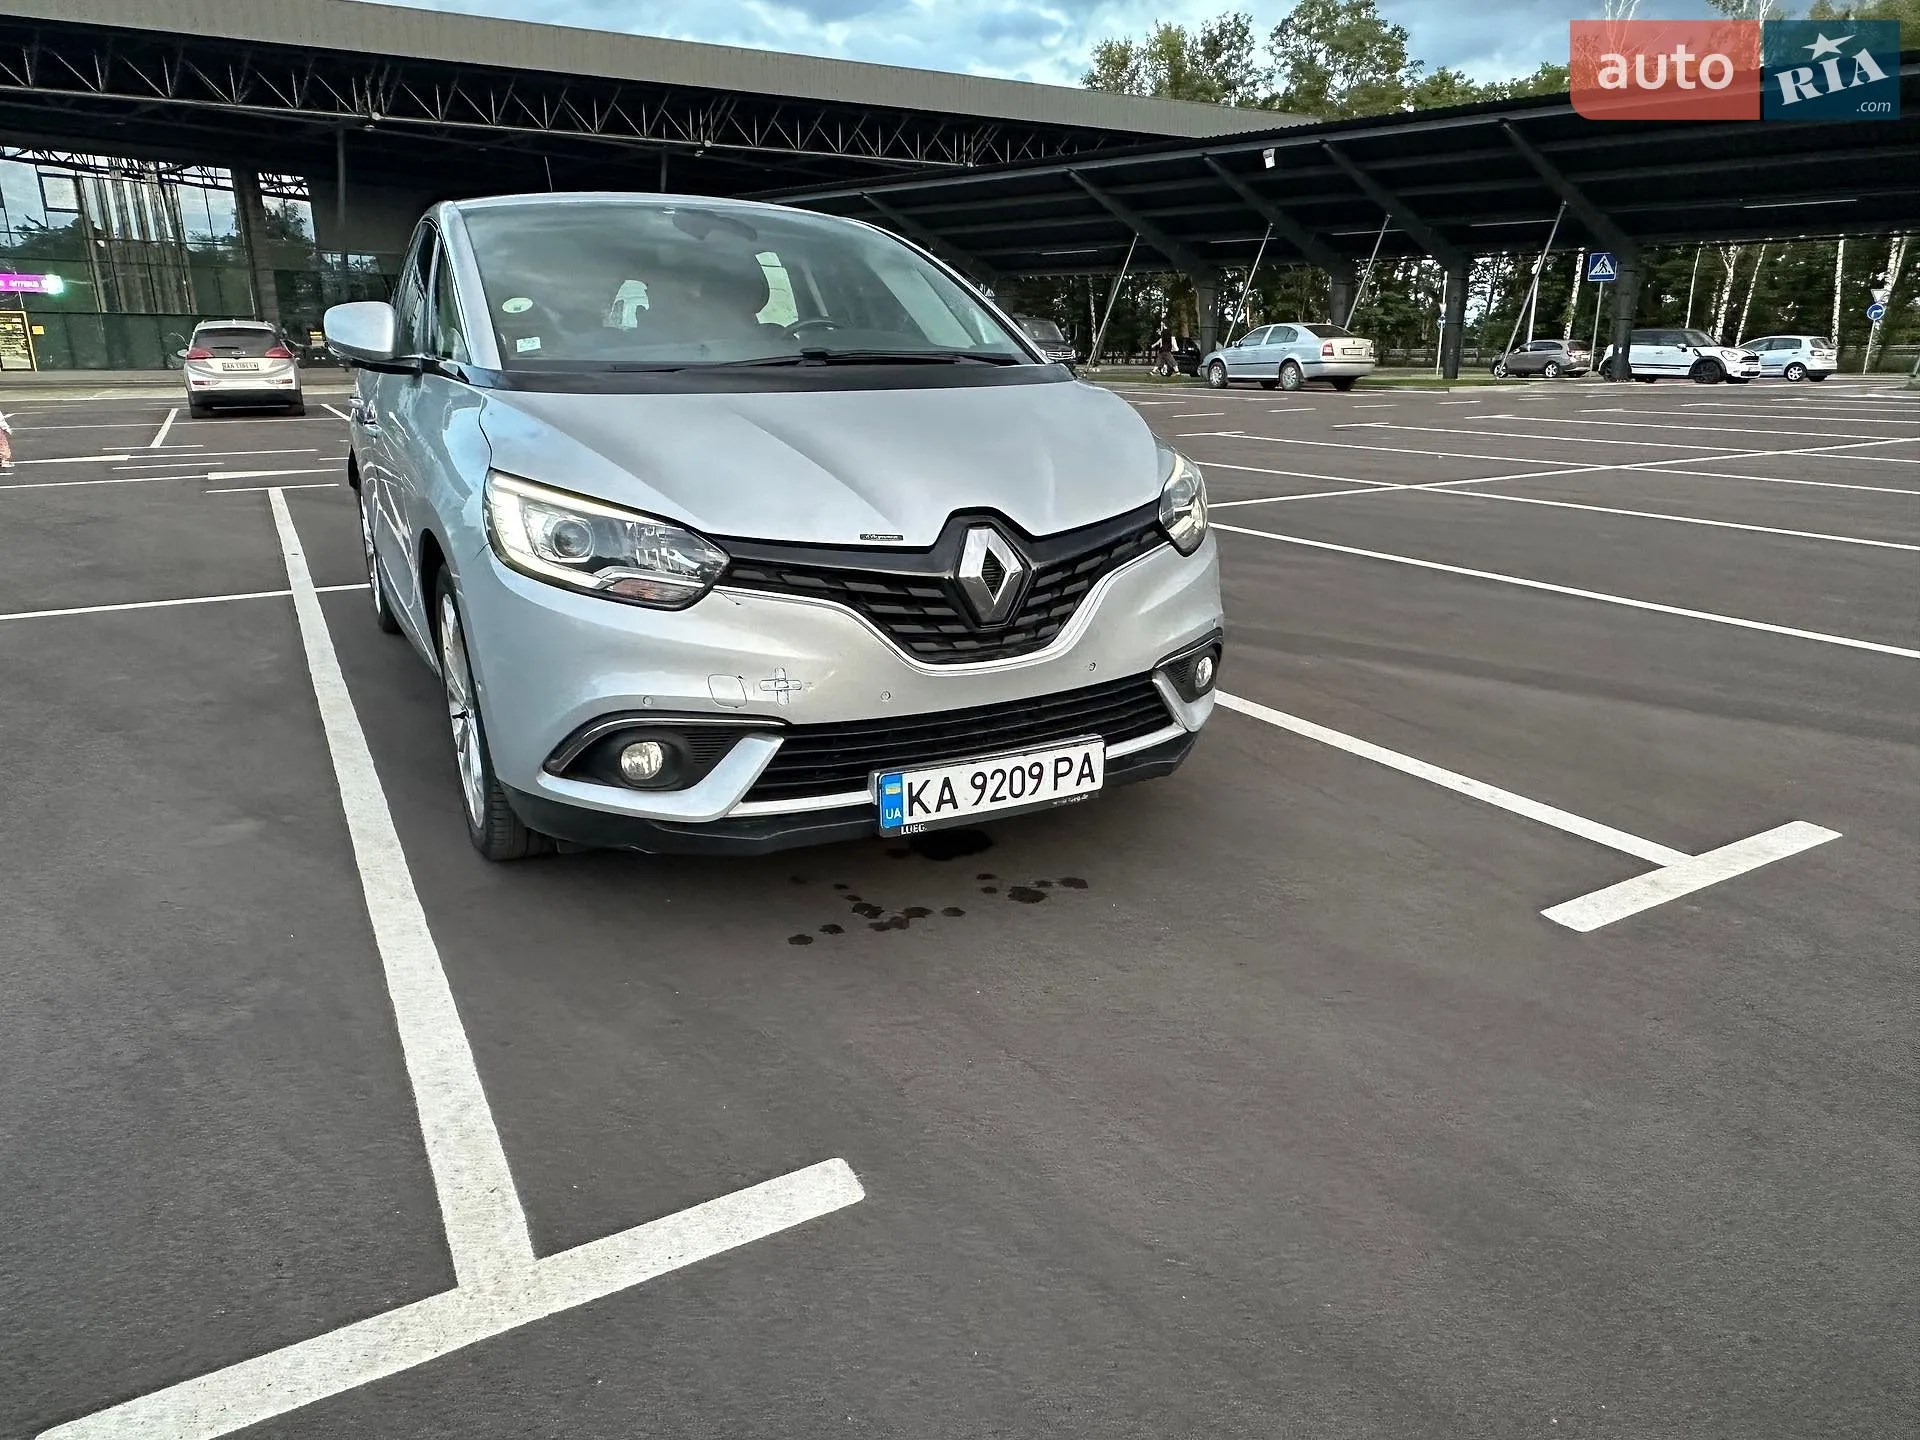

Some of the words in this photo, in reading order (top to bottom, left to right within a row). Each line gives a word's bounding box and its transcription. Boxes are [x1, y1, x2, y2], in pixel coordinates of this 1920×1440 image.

[907, 776, 959, 817] KA
[970, 761, 1044, 807] 9209
[1052, 752, 1096, 791] PA
[886, 808, 902, 820] UA
